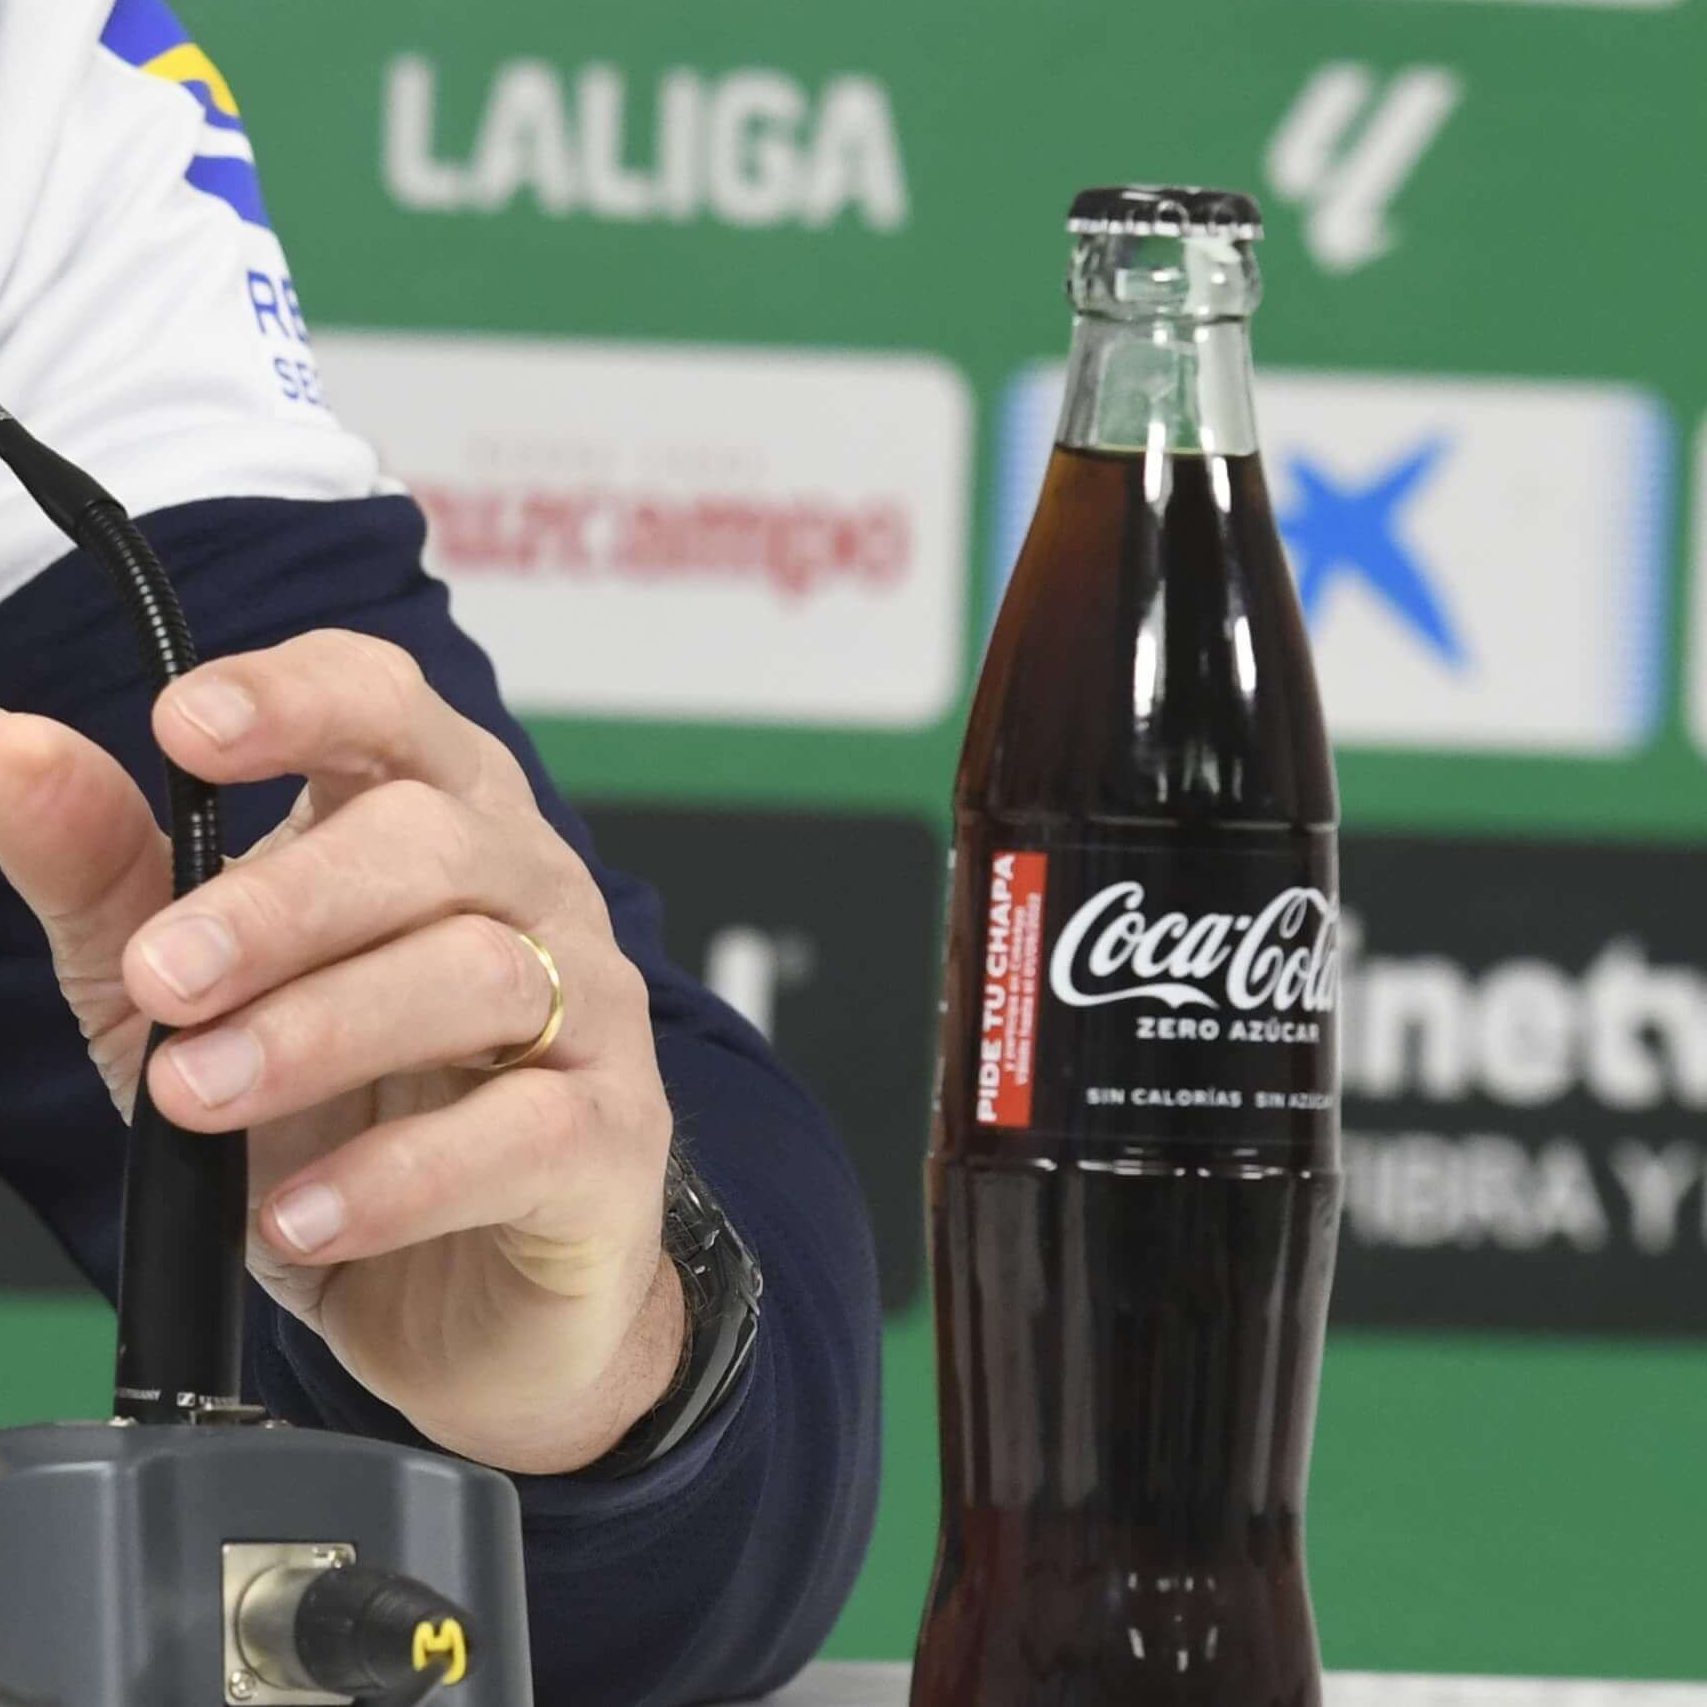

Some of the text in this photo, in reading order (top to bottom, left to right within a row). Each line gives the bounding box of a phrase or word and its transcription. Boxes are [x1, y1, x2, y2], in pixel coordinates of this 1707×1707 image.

[384, 54, 907, 232] LALIGA
[977, 854, 1015, 1123] PIDE TU CHAPA
[1136, 1016, 1320, 1043] ZERO AZÚCAR
[1086, 1087, 1125, 1105] SIN
[1131, 1084, 1242, 1108] CALORÍAS
